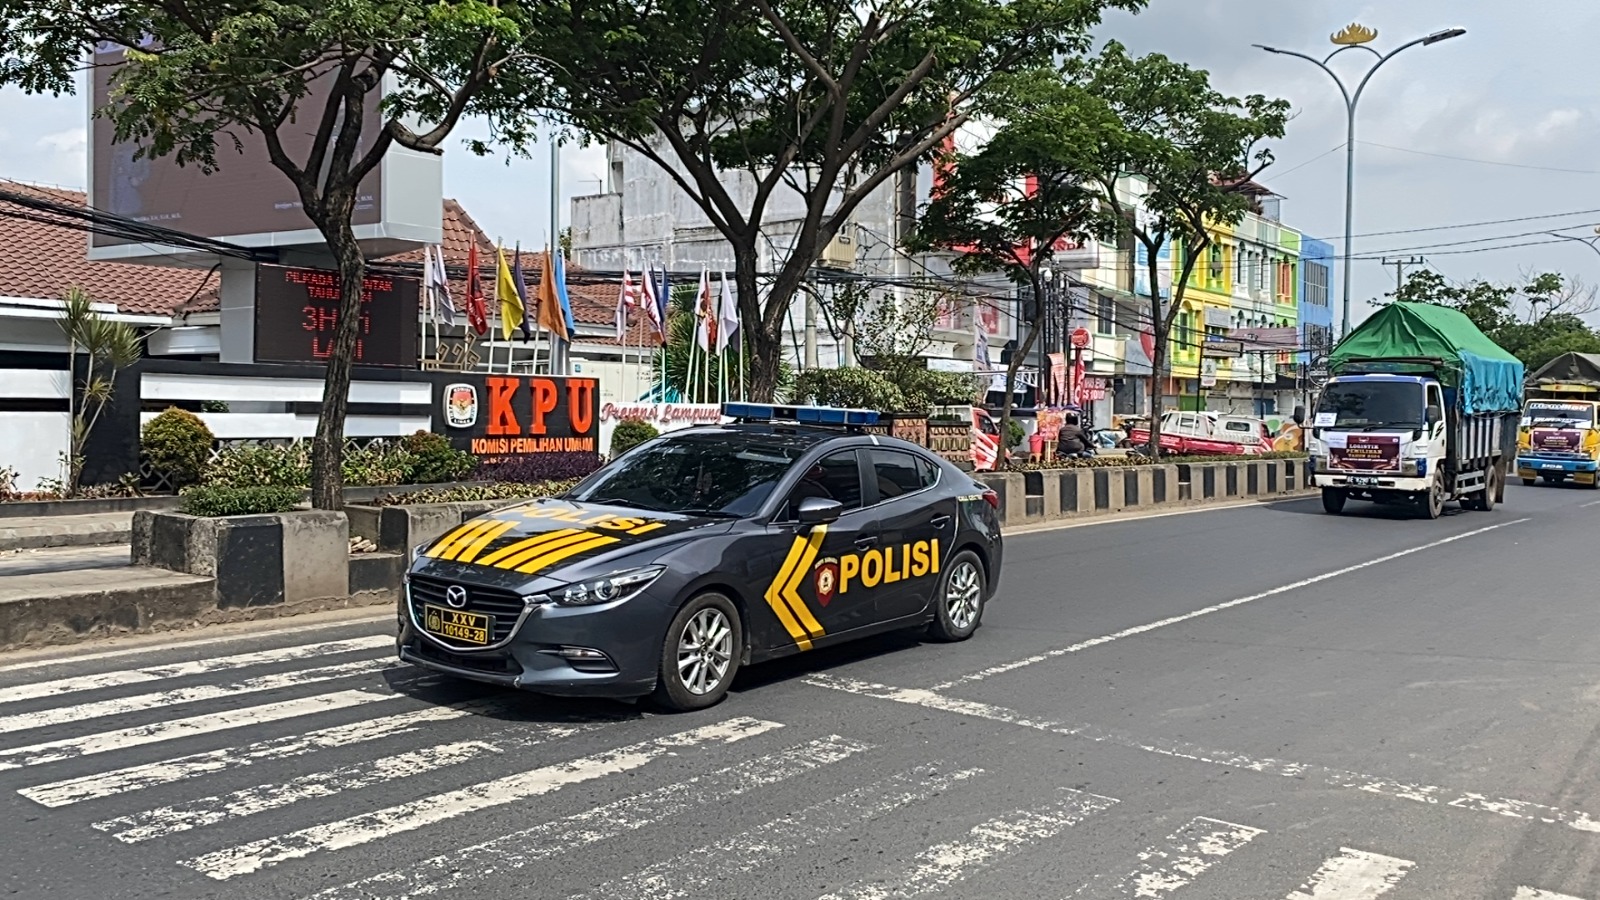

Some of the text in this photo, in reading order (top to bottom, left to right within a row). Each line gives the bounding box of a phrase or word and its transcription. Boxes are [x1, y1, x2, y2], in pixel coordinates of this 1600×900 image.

[285, 271, 334, 286] PILKADA
[485, 377, 595, 435] KPU
[660, 403, 721, 425] Lampung
[471, 437, 594, 454] KOMISI PEMILIHAN UMUM
[490, 504, 667, 536] POLISI
[839, 538, 940, 594] POLISI
[452, 613, 476, 627] XXV
[444, 624, 485, 642] 10149-28
